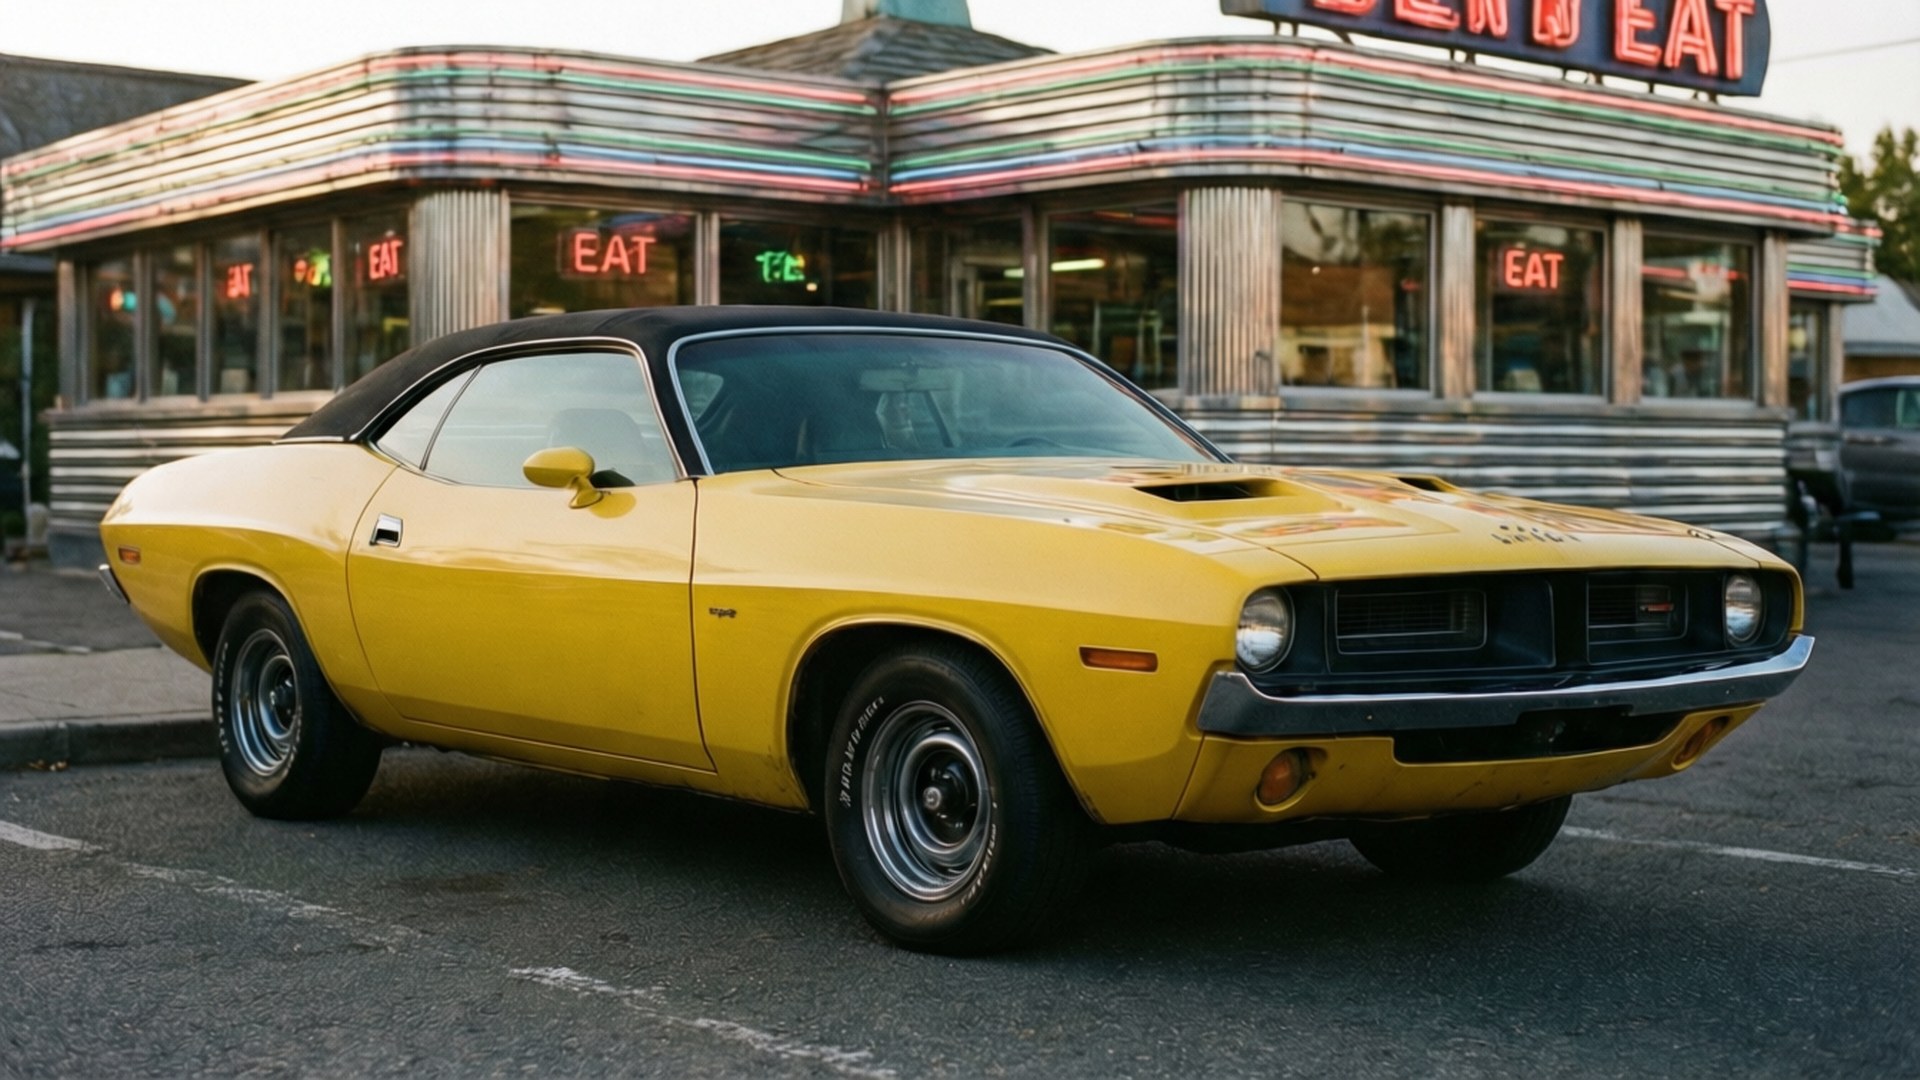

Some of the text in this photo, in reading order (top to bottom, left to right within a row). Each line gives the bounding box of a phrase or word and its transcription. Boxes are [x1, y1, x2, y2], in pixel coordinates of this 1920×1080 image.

[1615, 0, 1756, 79] EAT
[369, 240, 403, 279] EAT
[574, 232, 657, 274] EAT
[1505, 249, 1564, 289] EAT
